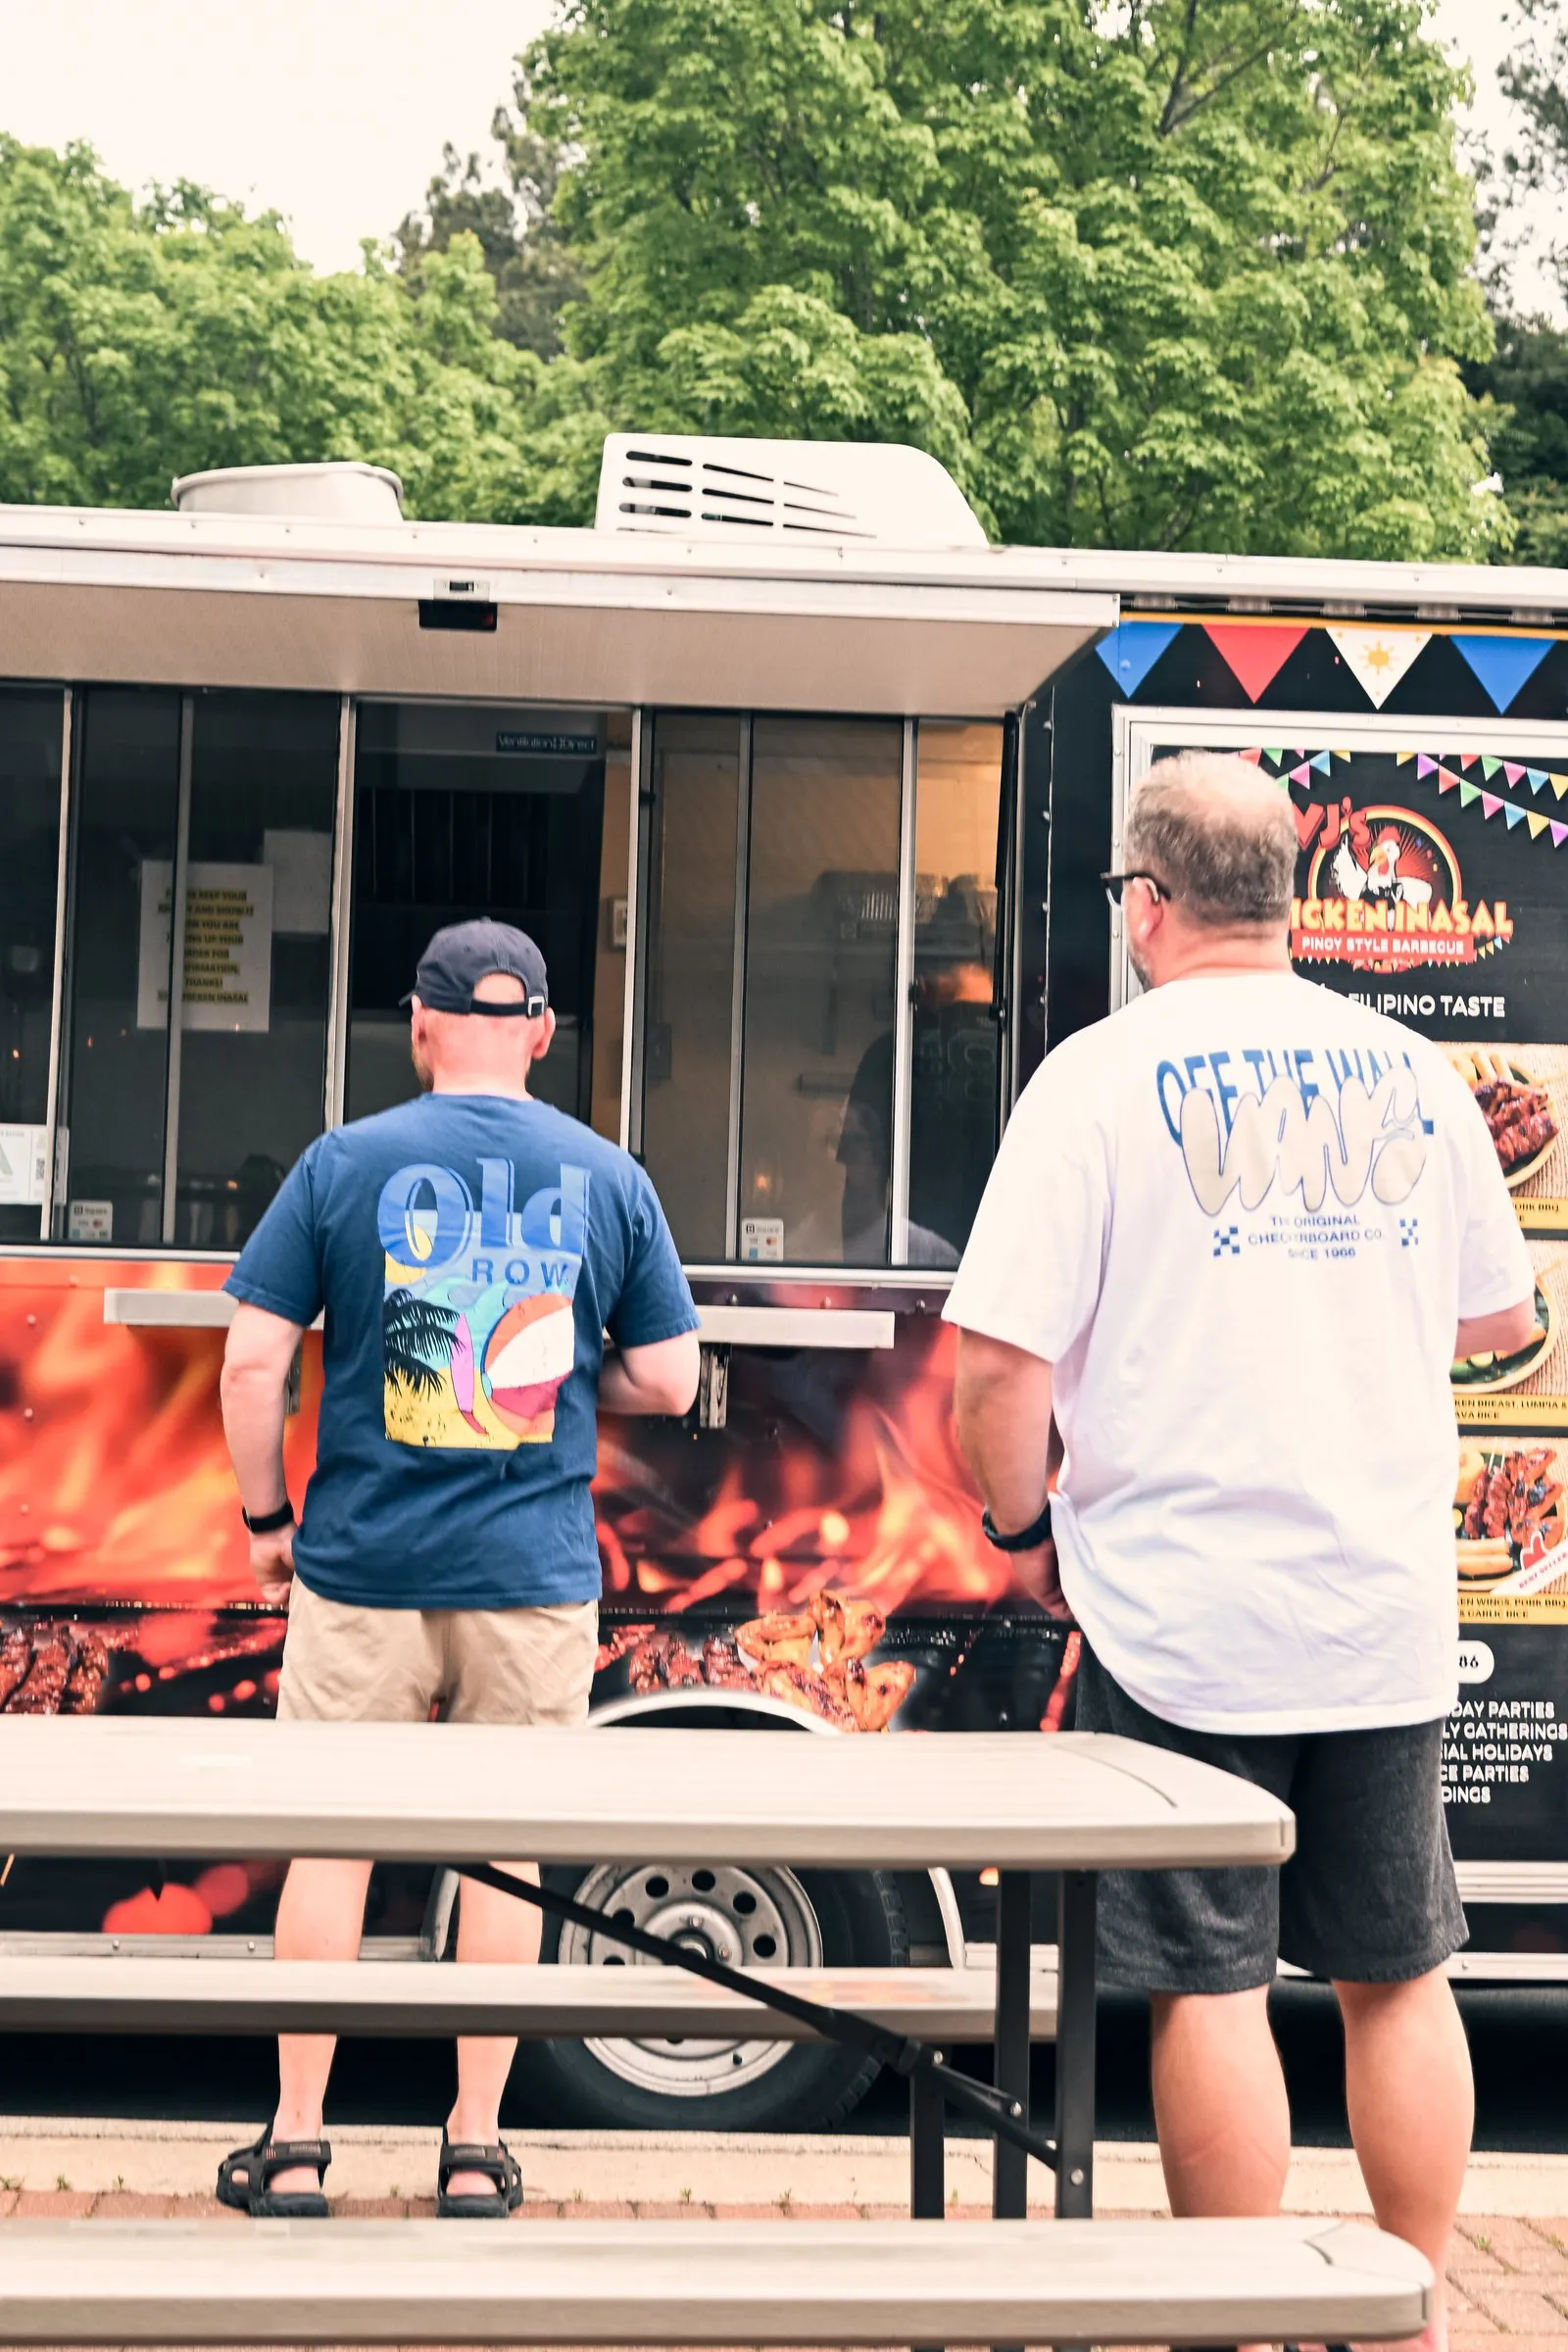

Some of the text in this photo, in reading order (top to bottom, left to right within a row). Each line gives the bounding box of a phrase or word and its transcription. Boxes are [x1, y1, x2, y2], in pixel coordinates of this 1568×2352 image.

[1291, 897, 1514, 938] ICKEN INASAL
[1301, 937, 1343, 951] PINOY
[1346, 937, 1389, 954] STYLE
[1440, 995, 1506, 1018] TASTE
[377, 1157, 592, 1268] Old
[1514, 1202, 1536, 1212] ORK
[1294, 1214, 1360, 1228] ORIGINAL
[1248, 1231, 1360, 1246] CHECRBOARD
[1325, 1247, 1356, 1258] 1966
[471, 1257, 569, 1289] ROW
[1514, 1598, 1542, 1607] PORK
[1489, 1701, 1555, 1719] PARTIES
[1463, 1722, 1568, 1740] GATHERINGS
[1472, 1743, 1553, 1762] HOLIDAYS
[1462, 1764, 1529, 1783] PARTIES
[1442, 1786, 1492, 1804] DINGS
